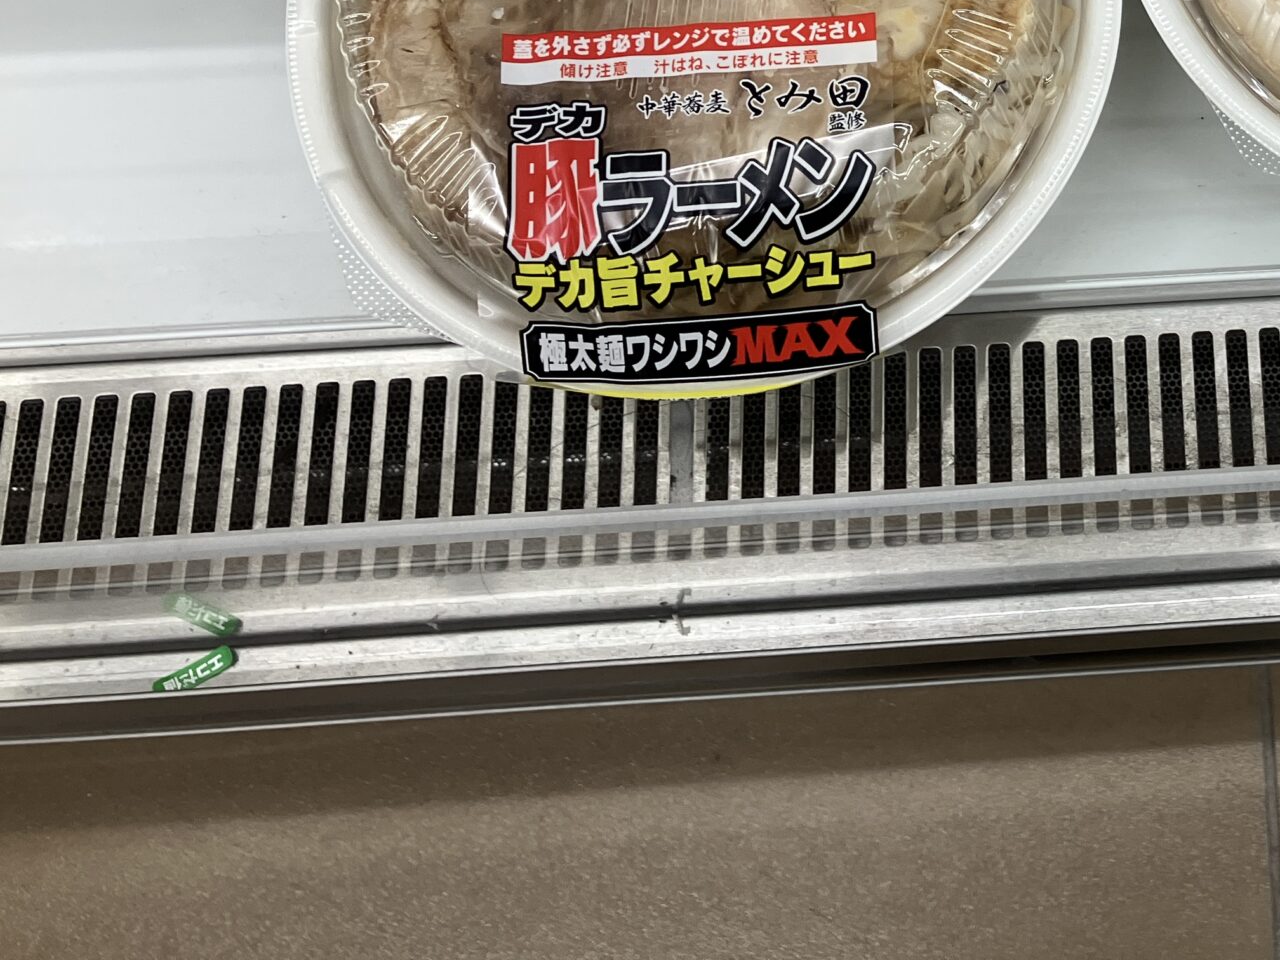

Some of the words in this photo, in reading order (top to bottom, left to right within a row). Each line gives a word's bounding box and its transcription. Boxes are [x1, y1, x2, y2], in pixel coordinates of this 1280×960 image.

[513, 21, 866, 60] 蓋を外さず必ずレンジで温めてください
[560, 61, 628, 79] 傾け注意
[654, 50, 819, 74] 汁はね、こぼれに注意
[637, 91, 731, 118] 中華蕎麦
[739, 76, 870, 118] とみ田
[509, 102, 606, 142] デカ
[828, 112, 865, 132] 監修
[513, 245, 875, 311] デカ旨チャーシュー
[539, 316, 865, 373] 極太麺ワシワシMAX
